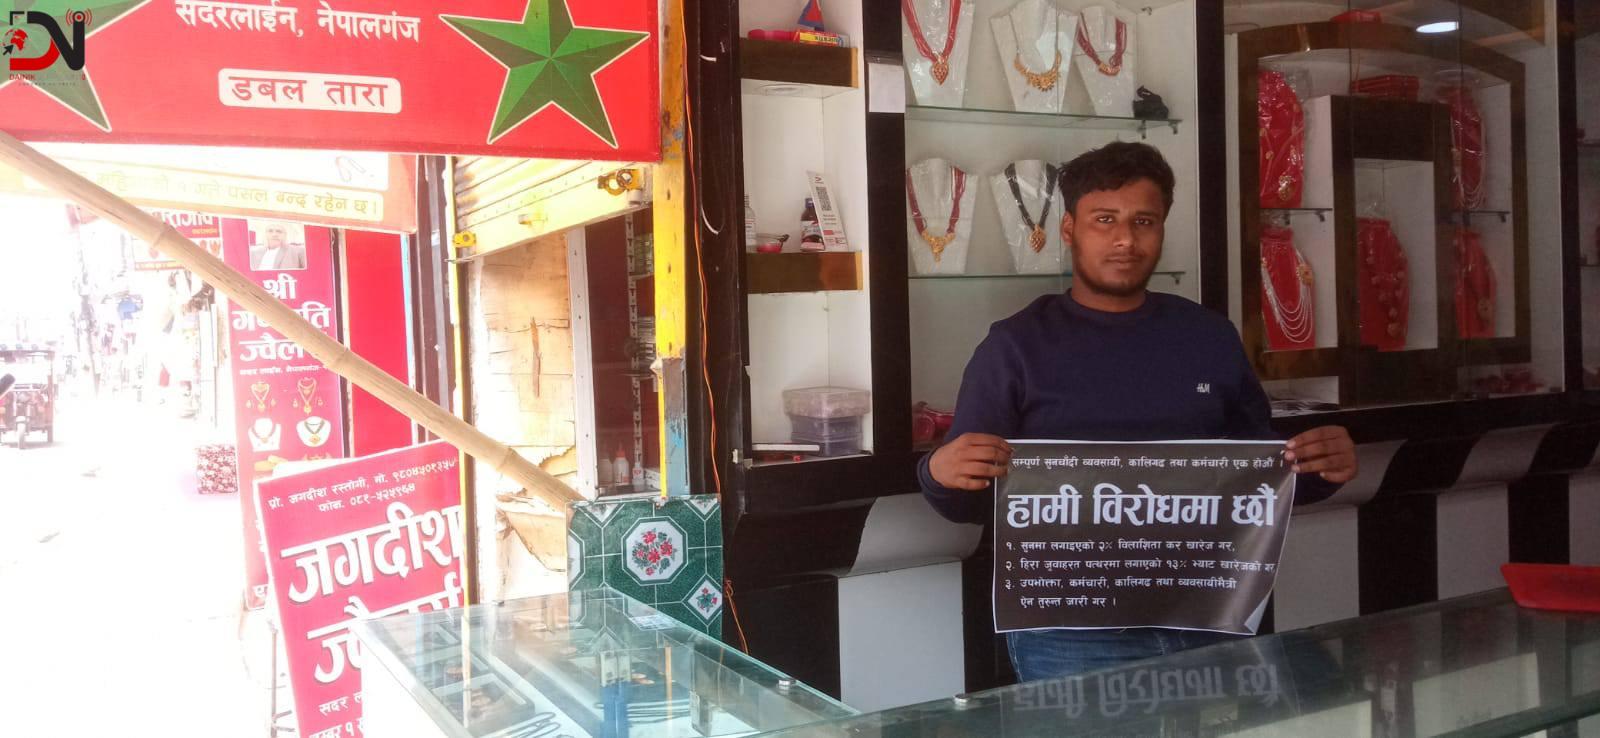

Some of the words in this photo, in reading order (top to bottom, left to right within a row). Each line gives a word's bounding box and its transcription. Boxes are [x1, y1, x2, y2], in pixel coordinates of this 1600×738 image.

[316, 1, 421, 42] नेपालगंज
[228, 76, 307, 103] डबल
[324, 81, 388, 107] तारा
[275, 191, 309, 208] बन्द
[1012, 456, 1041, 469] सम्पूर्ण
[1044, 455, 1079, 469] सुनचाँदी
[1083, 455, 1123, 468] व्यवसायी,
[1170, 458, 1188, 468] तथा
[1191, 456, 1229, 469] कर्मचारी
[1233, 459, 1249, 469] एक
[289, 487, 327, 504] जगदीश
[1007, 484, 1082, 528] हामी
[1093, 483, 1223, 526] विरोधमा
[282, 502, 463, 602] जगदीश
[1020, 541, 1047, 553] सुनमा
[1050, 540, 1095, 552] लगाइएको
[1165, 541, 1183, 551] कर
[1186, 539, 1214, 551] खारेज
[1020, 558, 1041, 571] हिरा
[1085, 560, 1121, 571] पत्थरमा
[1124, 558, 1161, 571] लगाएको
[1193, 560, 1217, 569] भ्याट
[1220, 560, 1263, 572] खारेजको
[1069, 576, 1110, 590] कर्मचारी,
[1156, 578, 1173, 587] तथा
[1020, 596, 1034, 608] ऐन
[1038, 598, 1062, 609] तुरुन्त
[1065, 595, 1089, 608] जारी
[1092, 598, 1107, 608] गर
[319, 696, 349, 716] सदर
